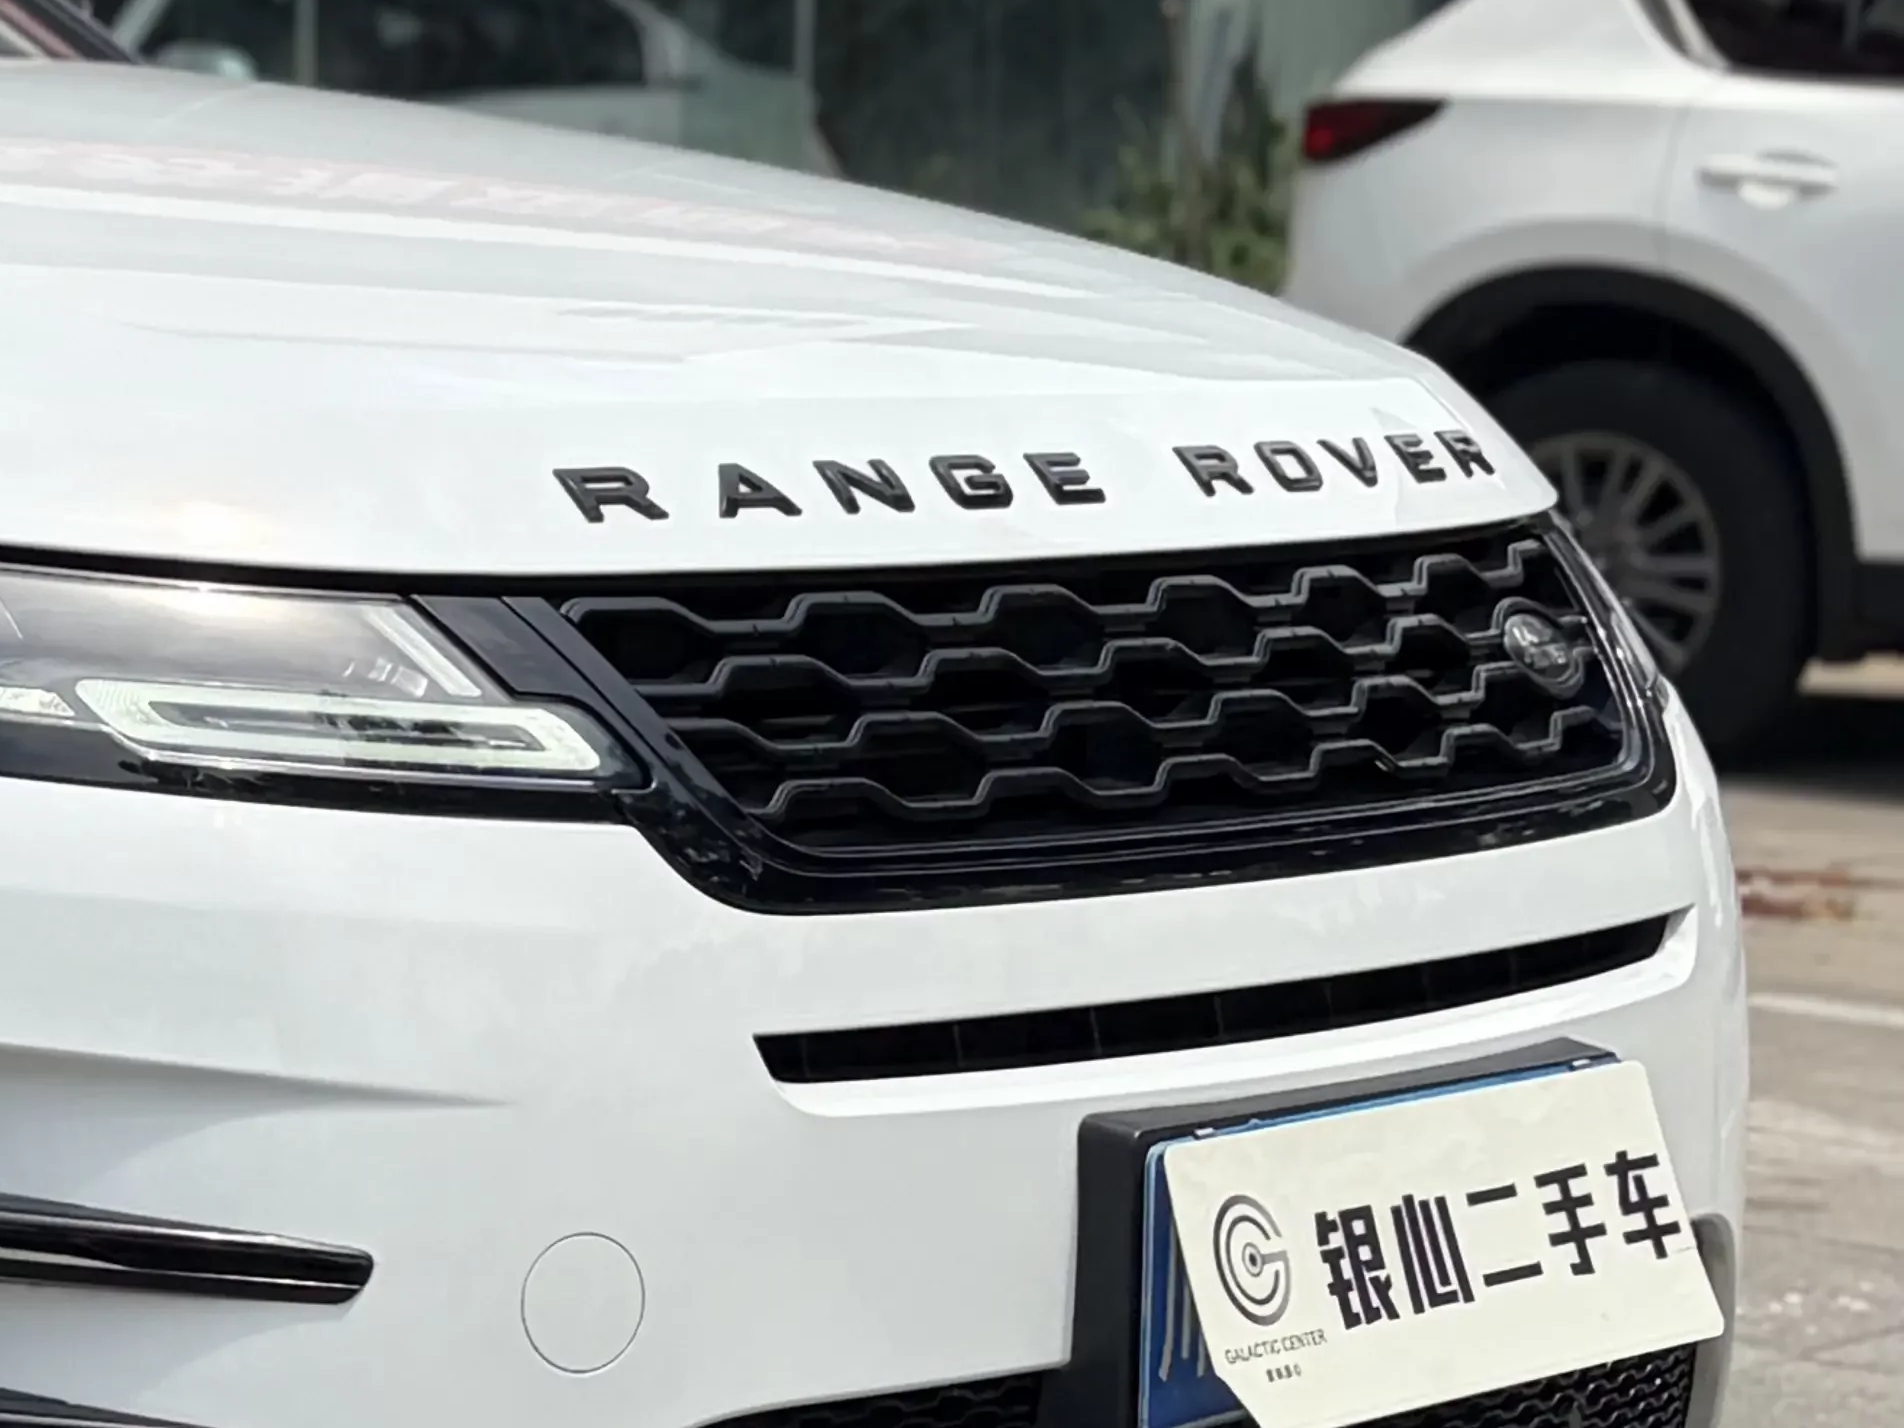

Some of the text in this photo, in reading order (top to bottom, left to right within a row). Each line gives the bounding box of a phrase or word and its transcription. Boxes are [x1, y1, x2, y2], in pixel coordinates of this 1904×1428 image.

[553, 428, 1496, 523] RANGE ROVER
[1314, 1150, 1681, 1330] 银心二手车
[1224, 1327, 1328, 1365] GALACTIC CENTER
